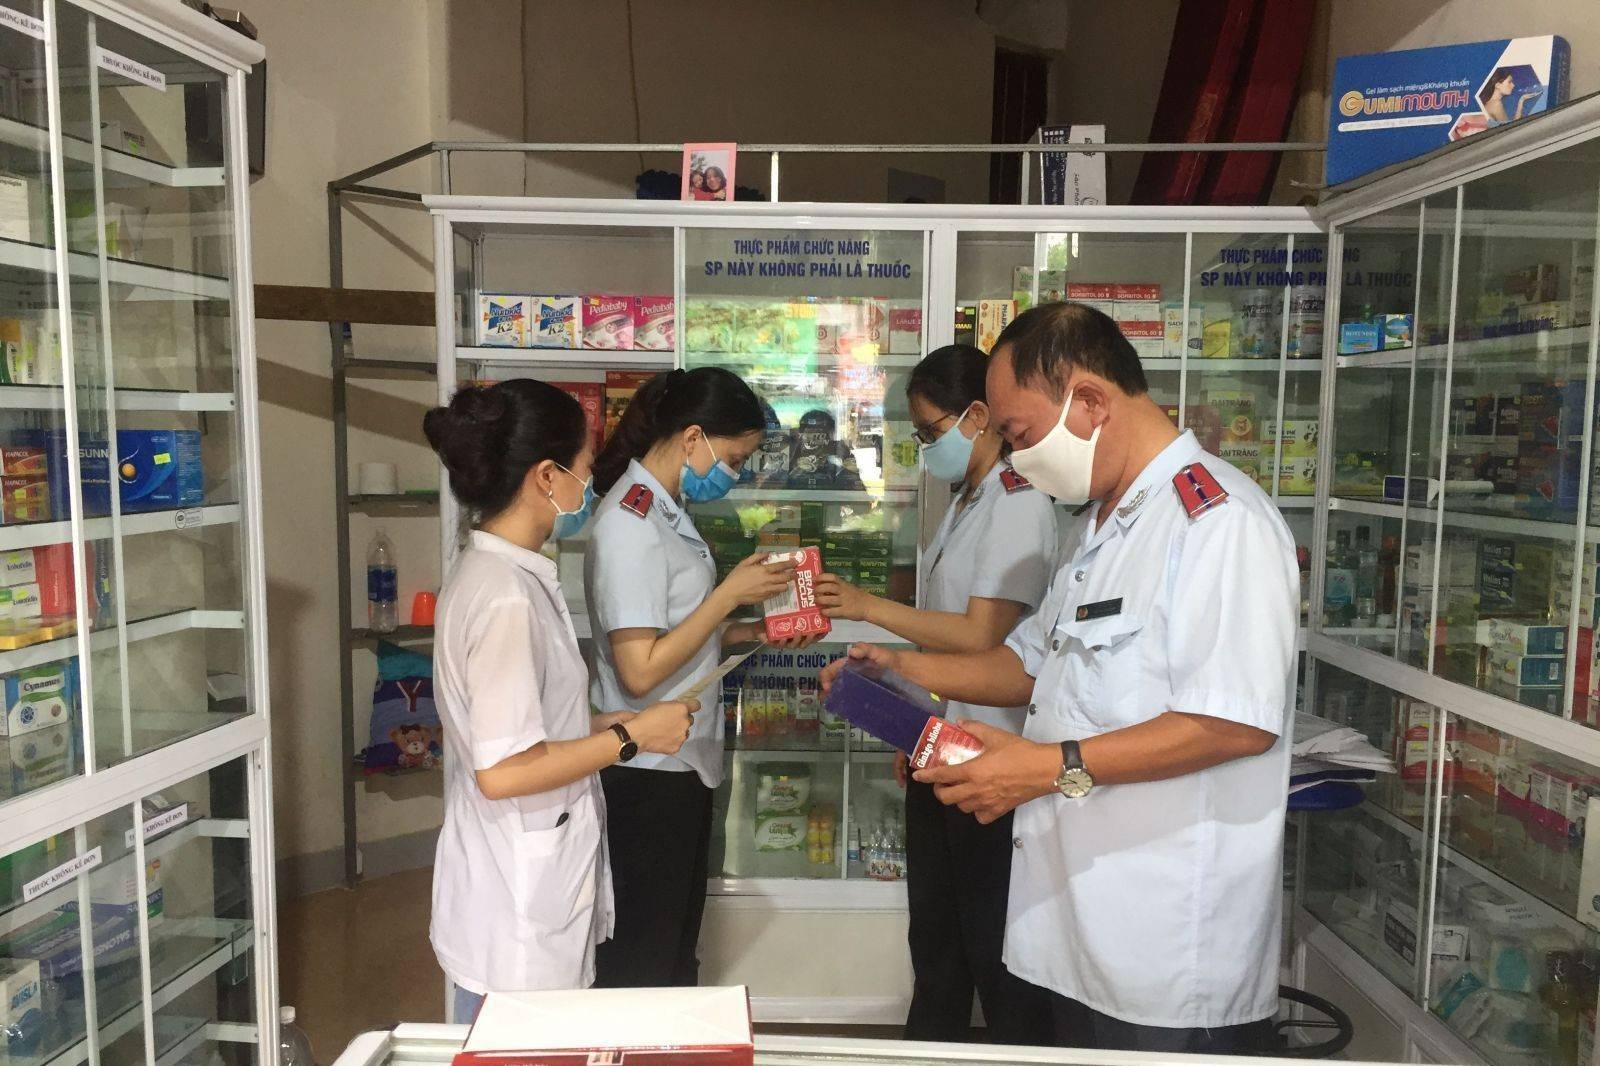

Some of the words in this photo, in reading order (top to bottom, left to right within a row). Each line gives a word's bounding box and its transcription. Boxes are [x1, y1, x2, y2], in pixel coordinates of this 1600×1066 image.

[734, 239, 763, 258] THỰC
[766, 235, 800, 255] PHẨM
[803, 238, 834, 255] CHỨC
[705, 261, 723, 276] SP
[727, 258, 755, 277] NÀY
[758, 260, 806, 277] KHÔNG
[809, 257, 842, 277] PHẢI
[846, 259, 863, 278] LÀ
[866, 258, 911, 279] THUỐC
[1219, 248, 1250, 268] THỰC
[1200, 271, 1219, 287] SP
[1223, 270, 1252, 287] NÀY
[1256, 269, 1305, 287] KHÔNG
[589, 300, 628, 316] Pediababy
[796, 571, 809, 608] FOCUS
[803, 569, 816, 607] BRAIN
[761, 649, 794, 668] PHẨM
[796, 652, 827, 668] CHỨC
[751, 674, 795, 690] KHÔNG
[396, 680, 421, 712] Y
[916, 743, 934, 768] Ginkgo
[926, 721, 944, 744] biloba
